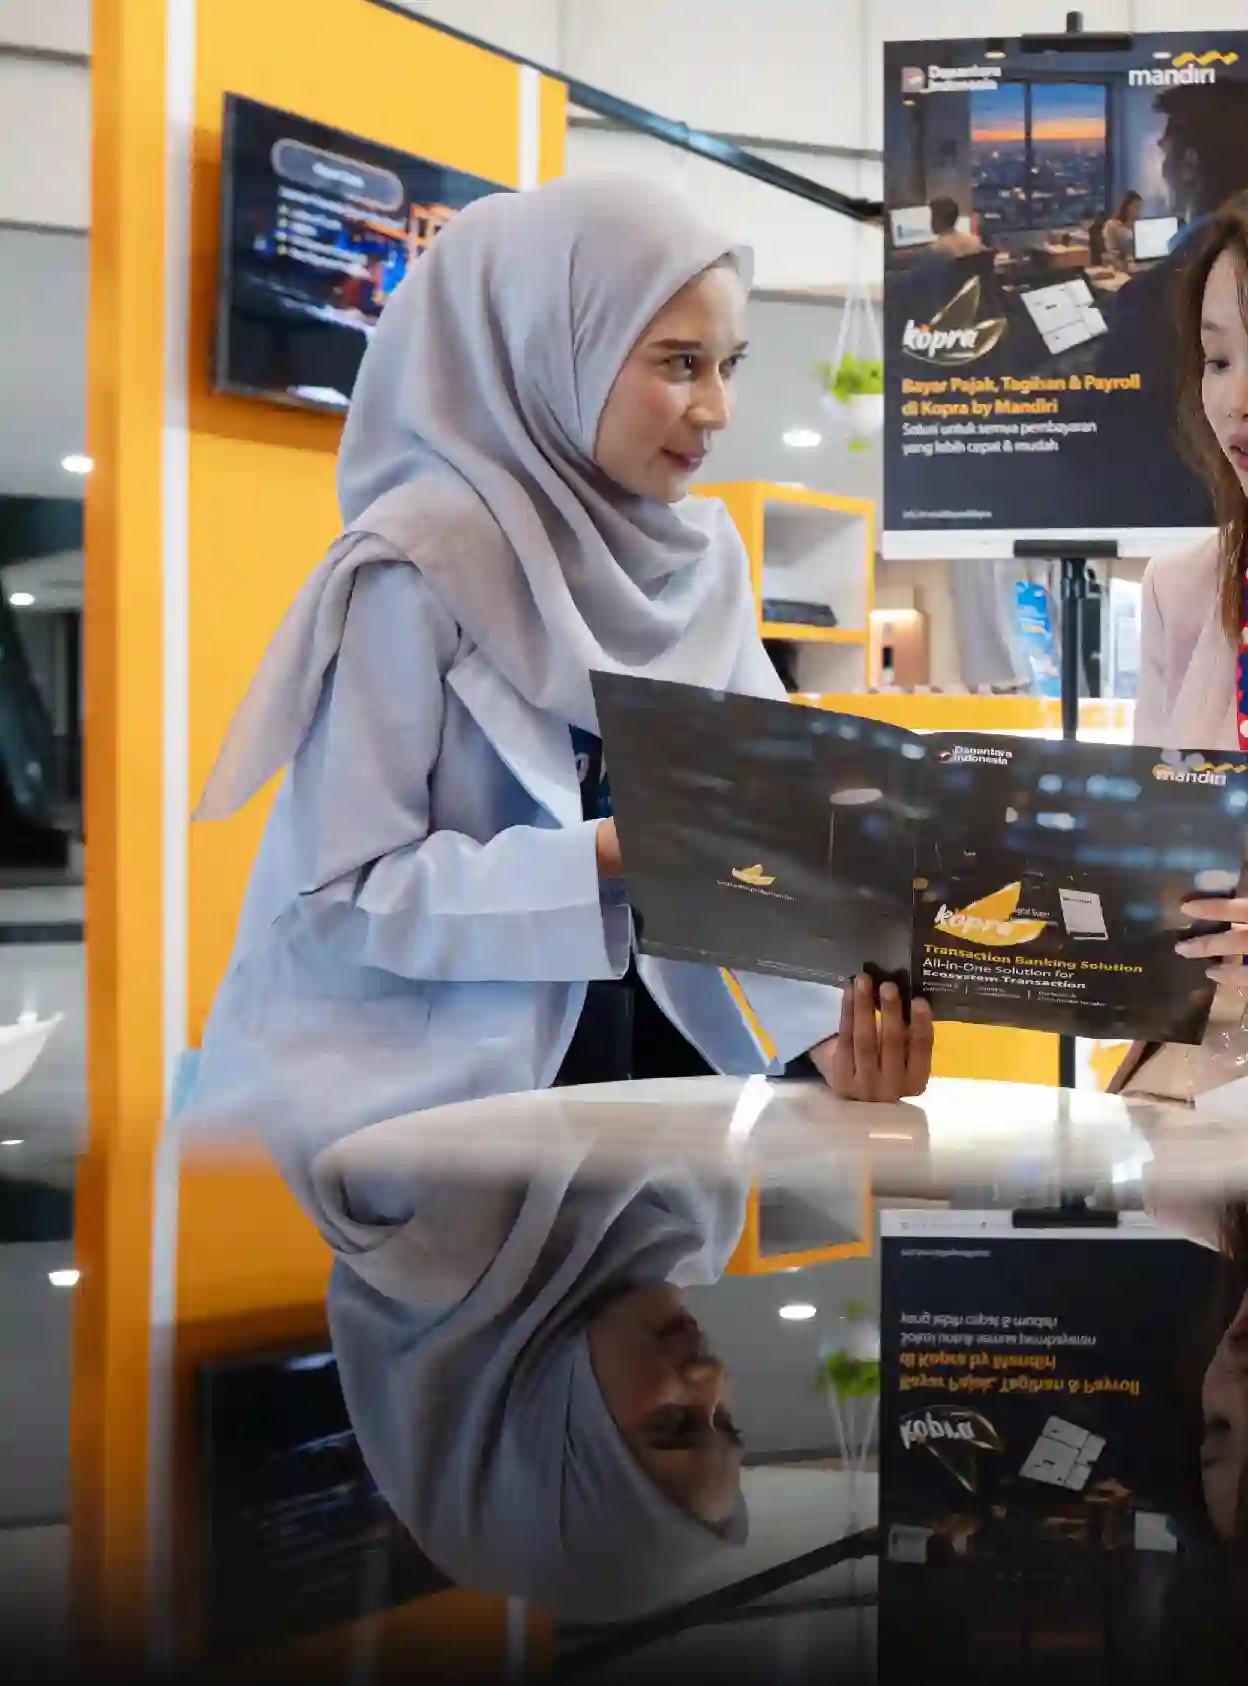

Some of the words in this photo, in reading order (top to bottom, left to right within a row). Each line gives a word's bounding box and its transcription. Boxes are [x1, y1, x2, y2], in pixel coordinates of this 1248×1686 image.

[903, 318, 979, 358] kopra
[1084, 373, 1141, 394] Payroll
[919, 400, 969, 419] Kopra
[971, 399, 993, 418] by
[923, 944, 1012, 964] Transaction
[1015, 956, 1077, 970] Banking
[1080, 961, 1143, 973] Solution
[923, 957, 992, 972] All-in-One
[1055, 969, 1075, 979] for
[923, 969, 999, 982] Ecosystem
[1002, 976, 1086, 989] Transaction
